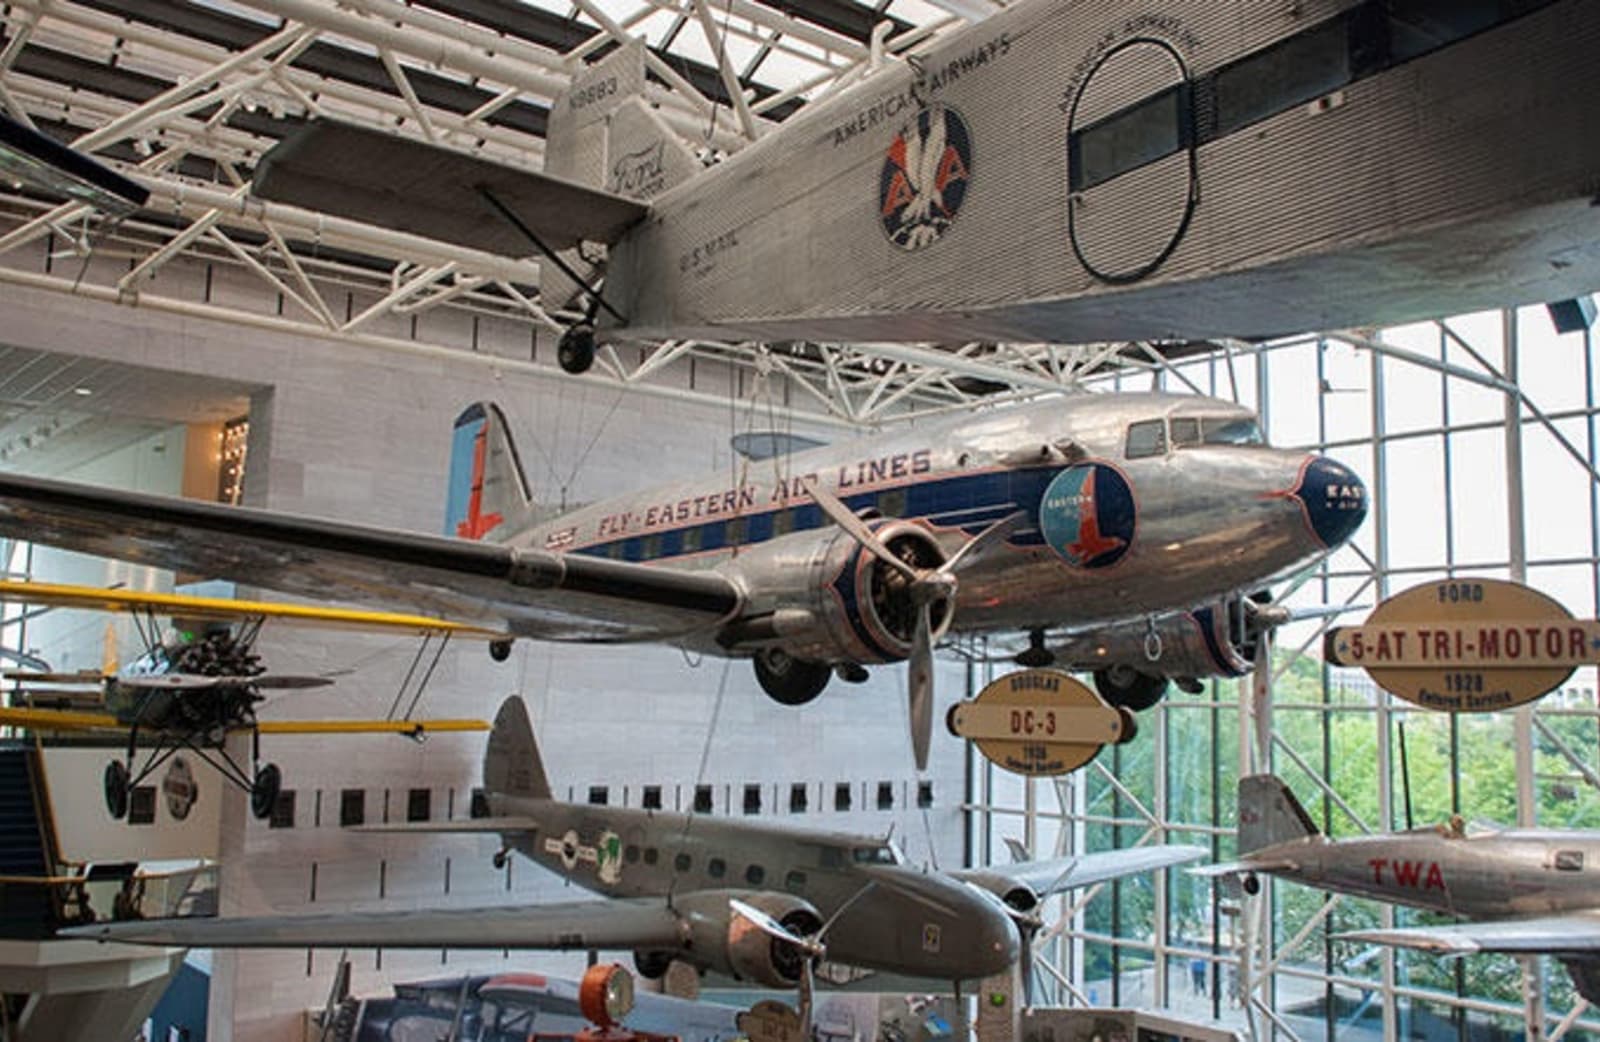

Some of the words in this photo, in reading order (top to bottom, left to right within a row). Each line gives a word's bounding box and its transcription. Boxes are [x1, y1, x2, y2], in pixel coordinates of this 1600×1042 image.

[929, 33, 1010, 93] AIRWAYS
[838, 450, 931, 488] LINES
[1437, 584, 1484, 603] FORD
[1351, 632, 1406, 661] 5-AT
[1417, 627, 1588, 661] TRI-MOTOR
[1010, 675, 1060, 693] DOUGLAS
[1445, 674, 1484, 693] 1928
[1010, 710, 1057, 736] DC-3
[1367, 857, 1446, 891] TWA
